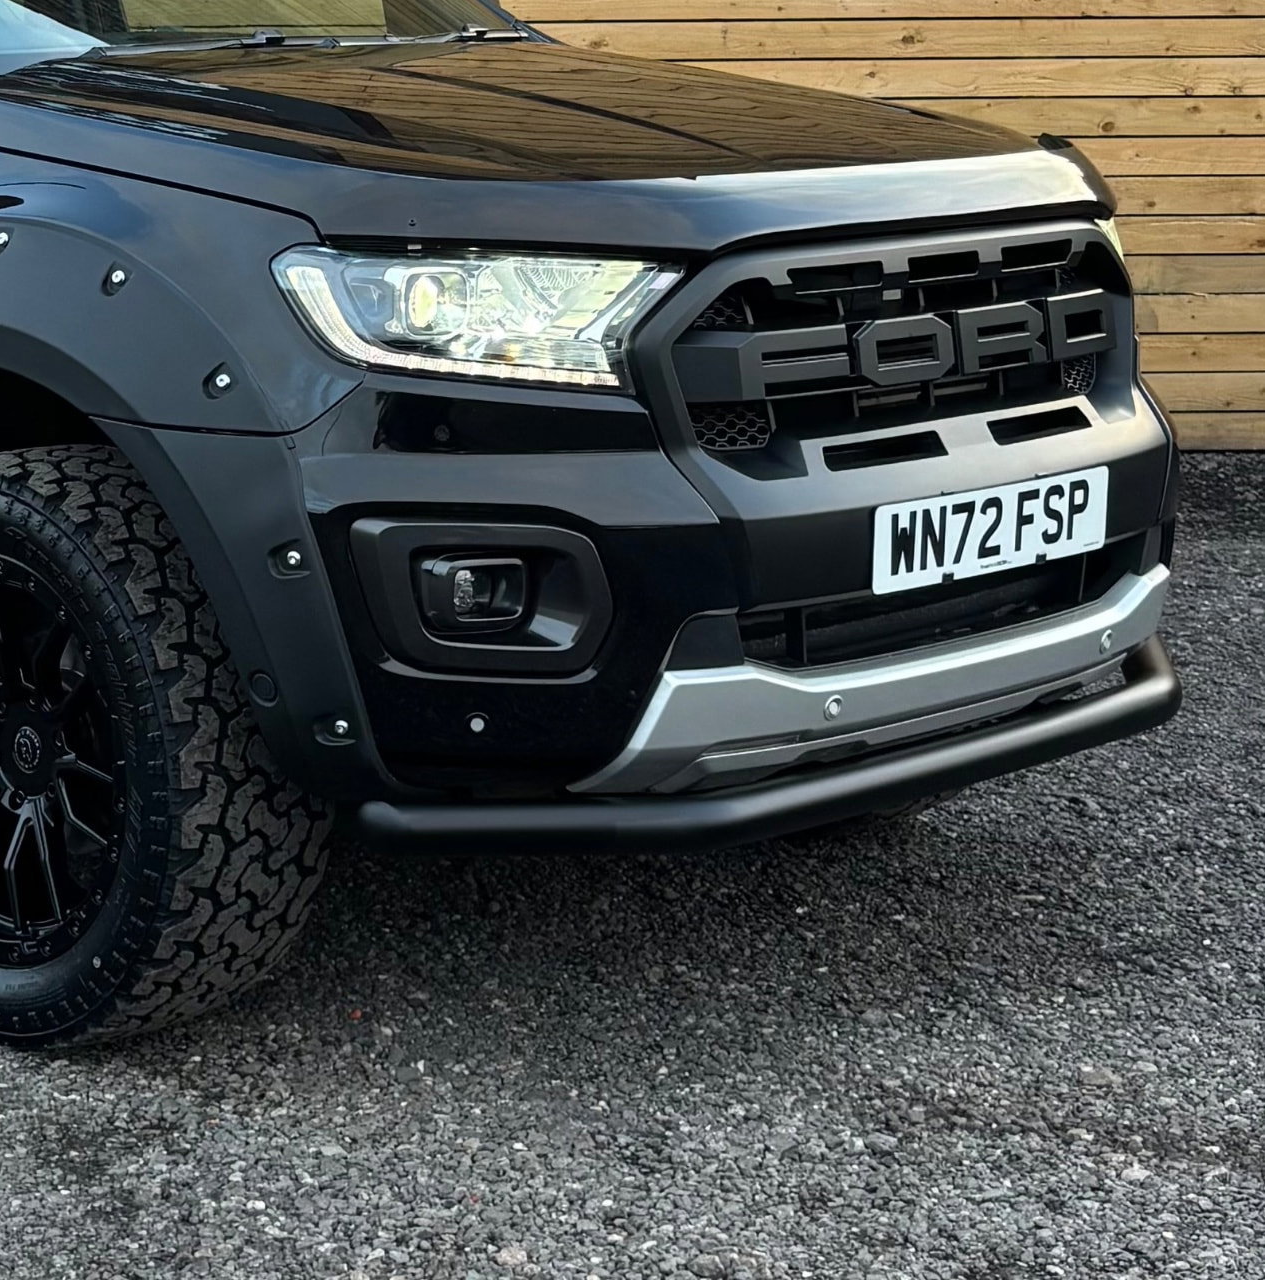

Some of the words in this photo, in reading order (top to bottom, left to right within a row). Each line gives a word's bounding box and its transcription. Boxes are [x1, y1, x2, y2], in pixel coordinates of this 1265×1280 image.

[737, 288, 1117, 401] FORD
[890, 496, 1002, 576] WN72
[1014, 479, 1090, 552] FSP
